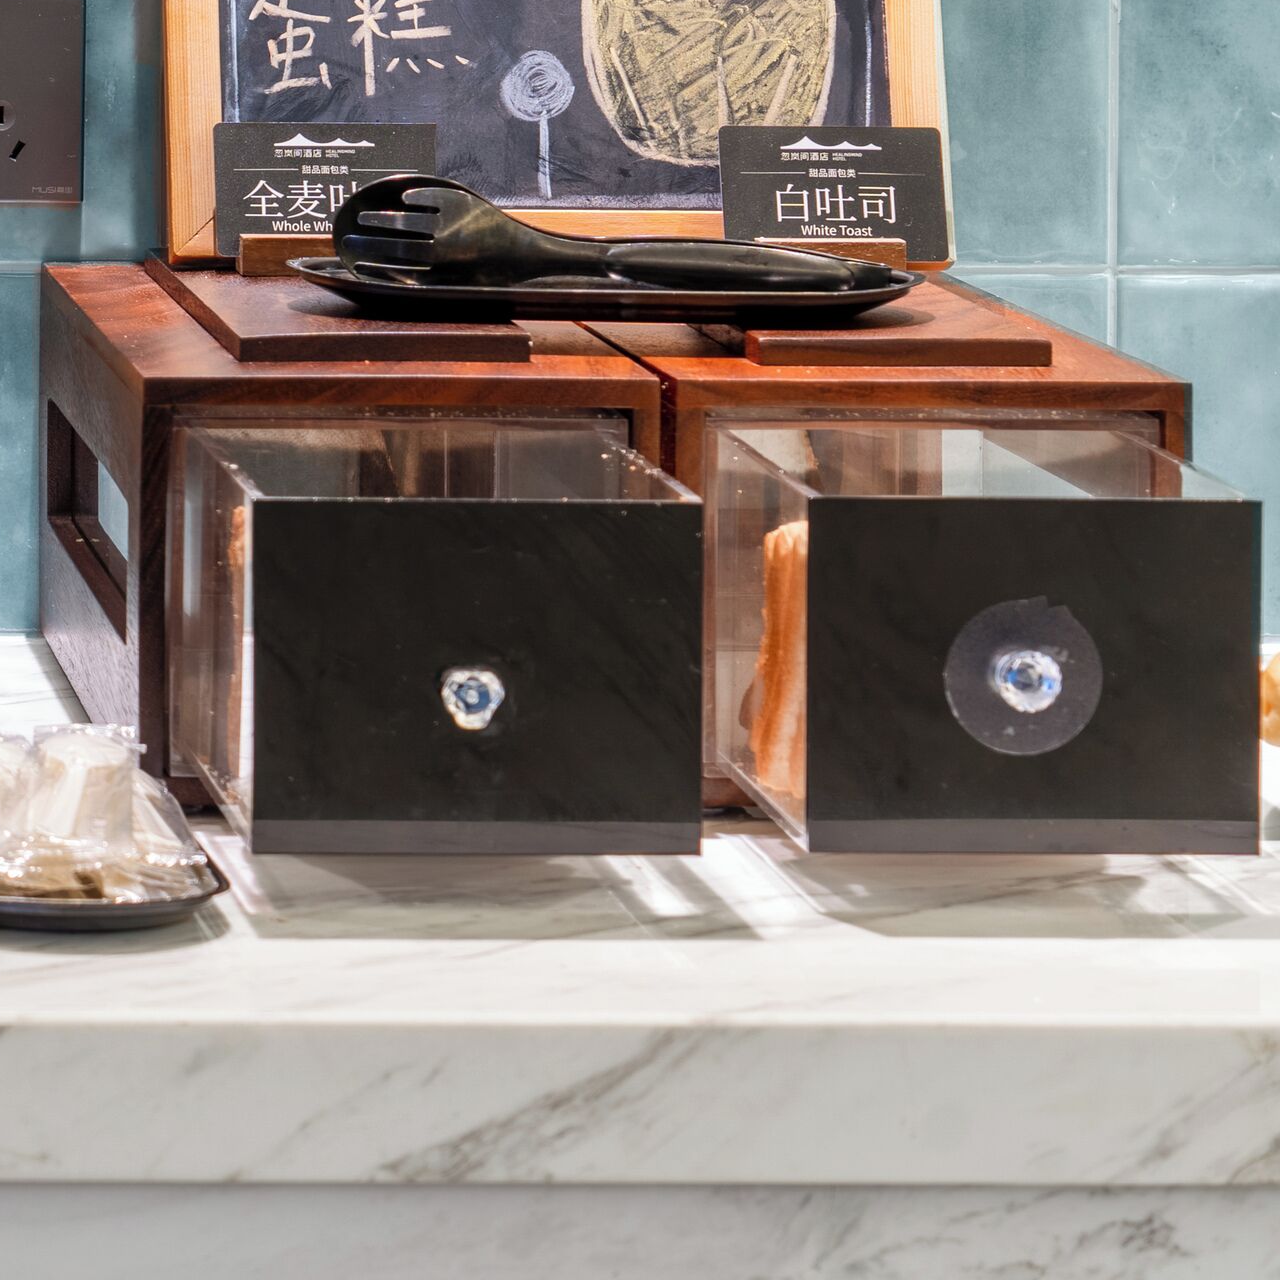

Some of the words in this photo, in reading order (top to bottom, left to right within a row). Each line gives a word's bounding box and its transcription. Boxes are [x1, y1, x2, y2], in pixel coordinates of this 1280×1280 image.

[301, 165, 349, 175] 甜品面包类
[808, 168, 856, 178] 甜品面包类
[775, 184, 896, 224] 白吐司
[272, 220, 311, 232] Whole
[801, 225, 837, 236] White
[839, 225, 873, 236] Toast
